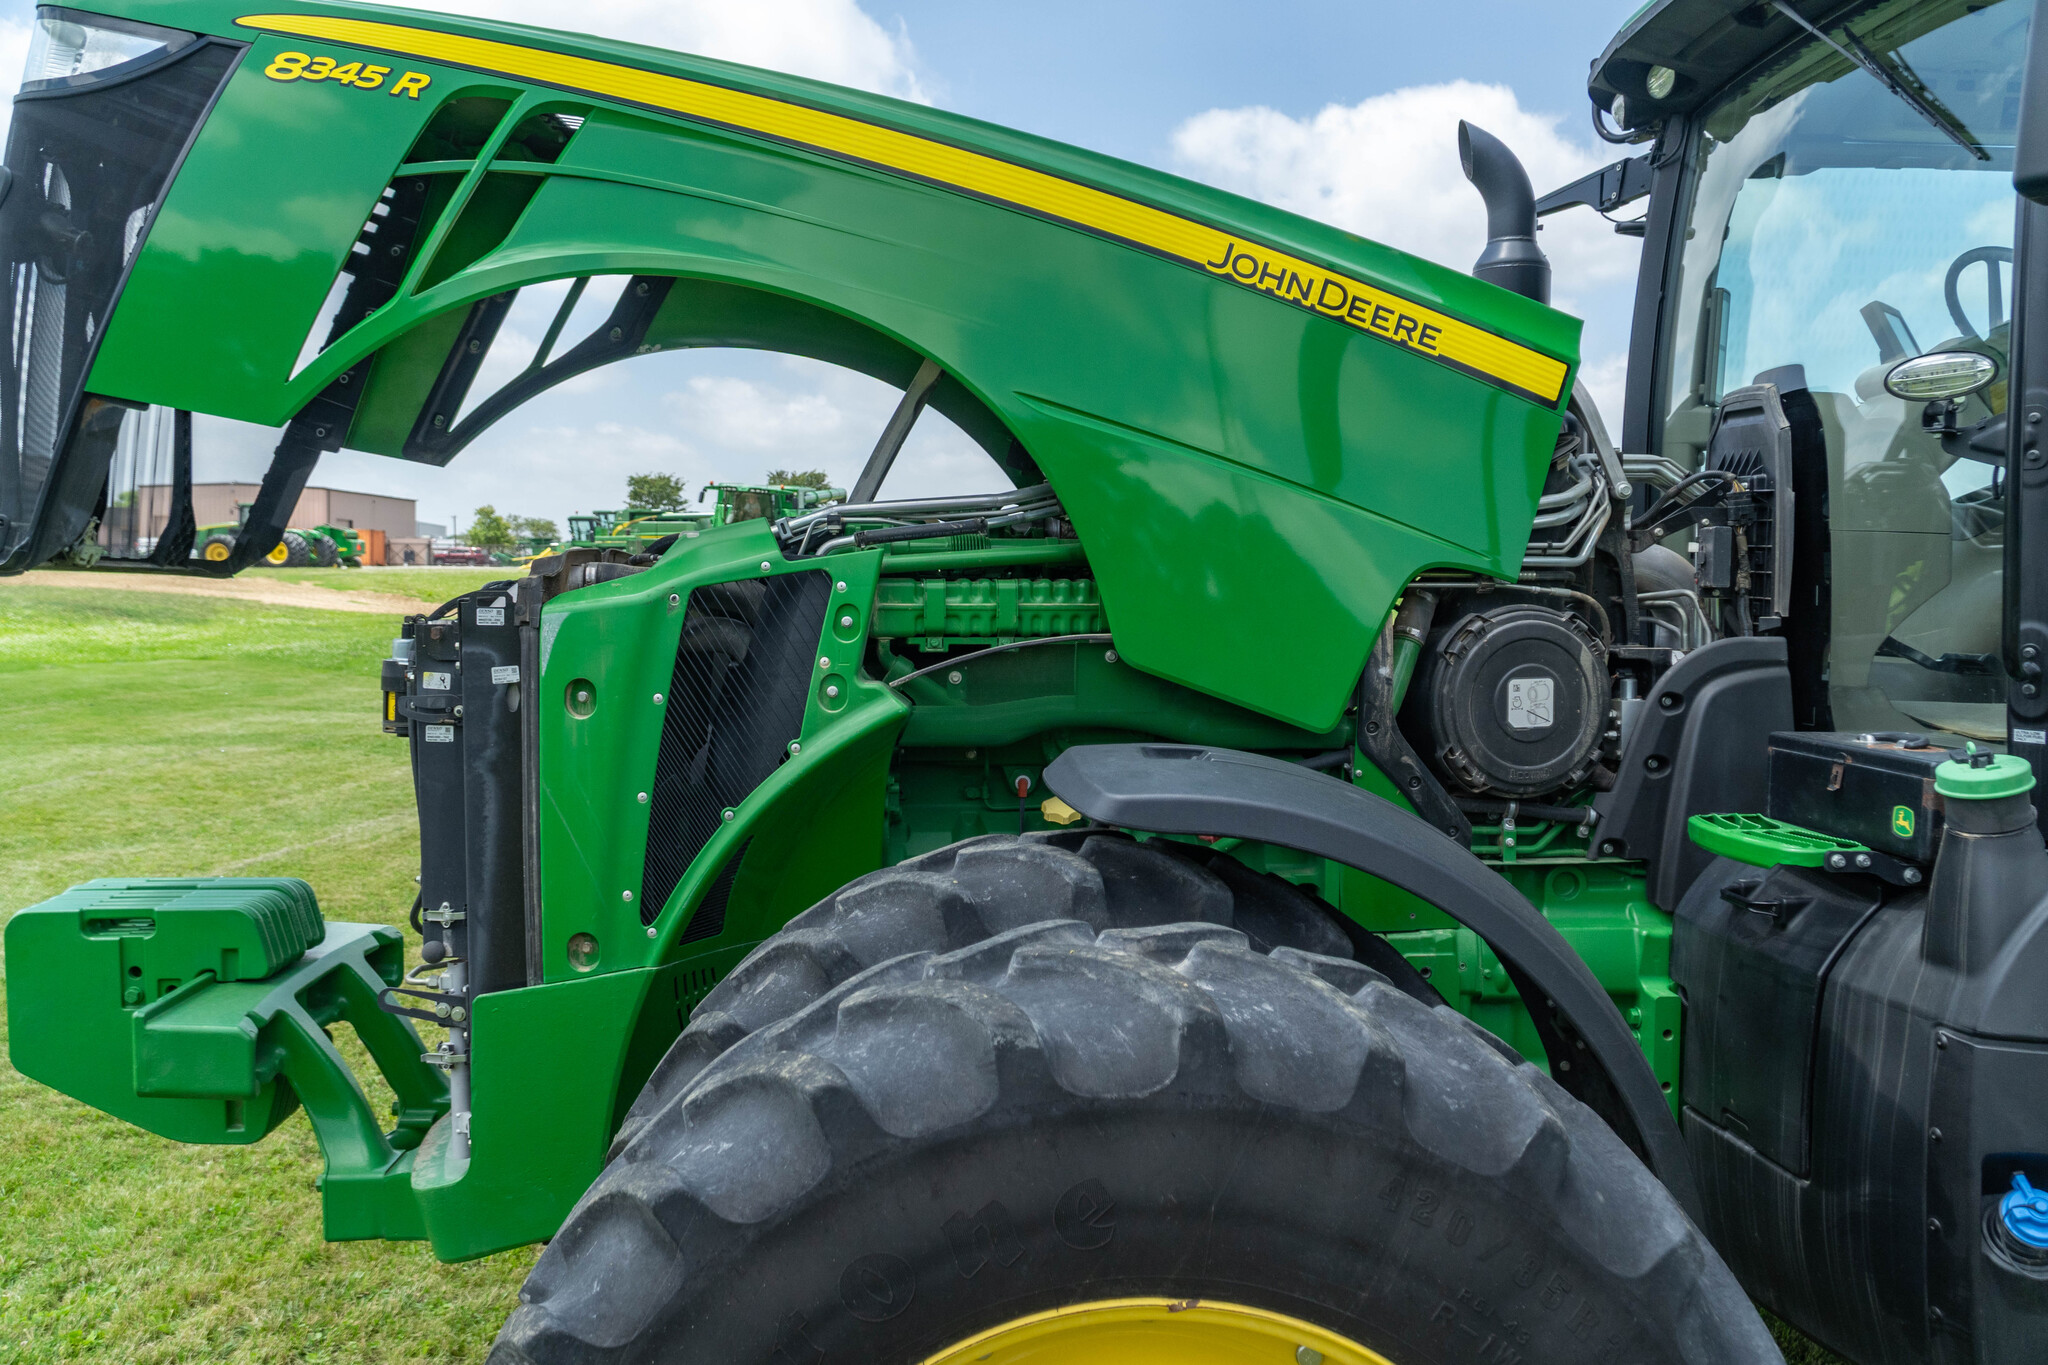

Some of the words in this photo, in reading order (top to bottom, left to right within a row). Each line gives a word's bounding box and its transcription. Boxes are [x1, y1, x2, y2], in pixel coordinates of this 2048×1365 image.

[264, 51, 394, 92] 8345
[388, 70, 432, 101] R
[1206, 242, 1315, 302] JOHN
[1316, 277, 1443, 351] DEERE
